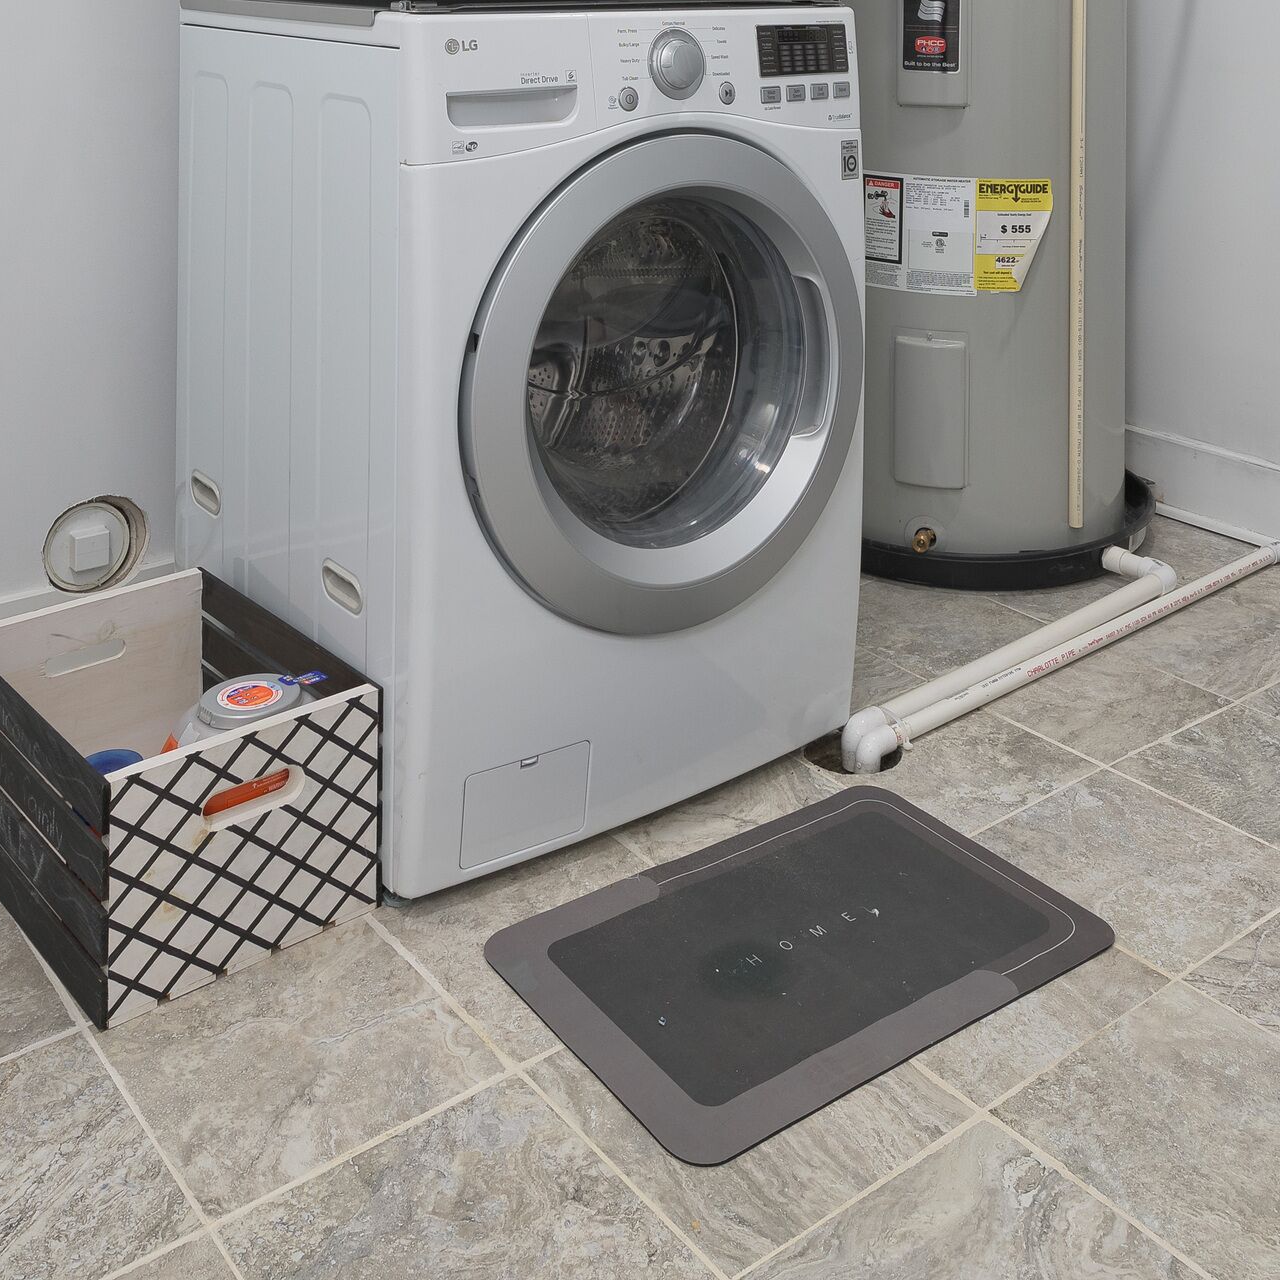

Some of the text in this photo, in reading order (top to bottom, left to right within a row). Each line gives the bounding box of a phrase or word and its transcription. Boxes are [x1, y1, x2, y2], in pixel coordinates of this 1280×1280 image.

[462, 40, 478, 51] LG
[521, 75, 559, 85] Direct Drive
[979, 184, 1048, 194] ENERGYGUIDE
[1000, 224, 1032, 234] $ 555
[1026, 657, 1059, 677] CHARLOTTE
[1060, 648, 1076, 660] PIPE
[747, 910, 856, 968] HOME
